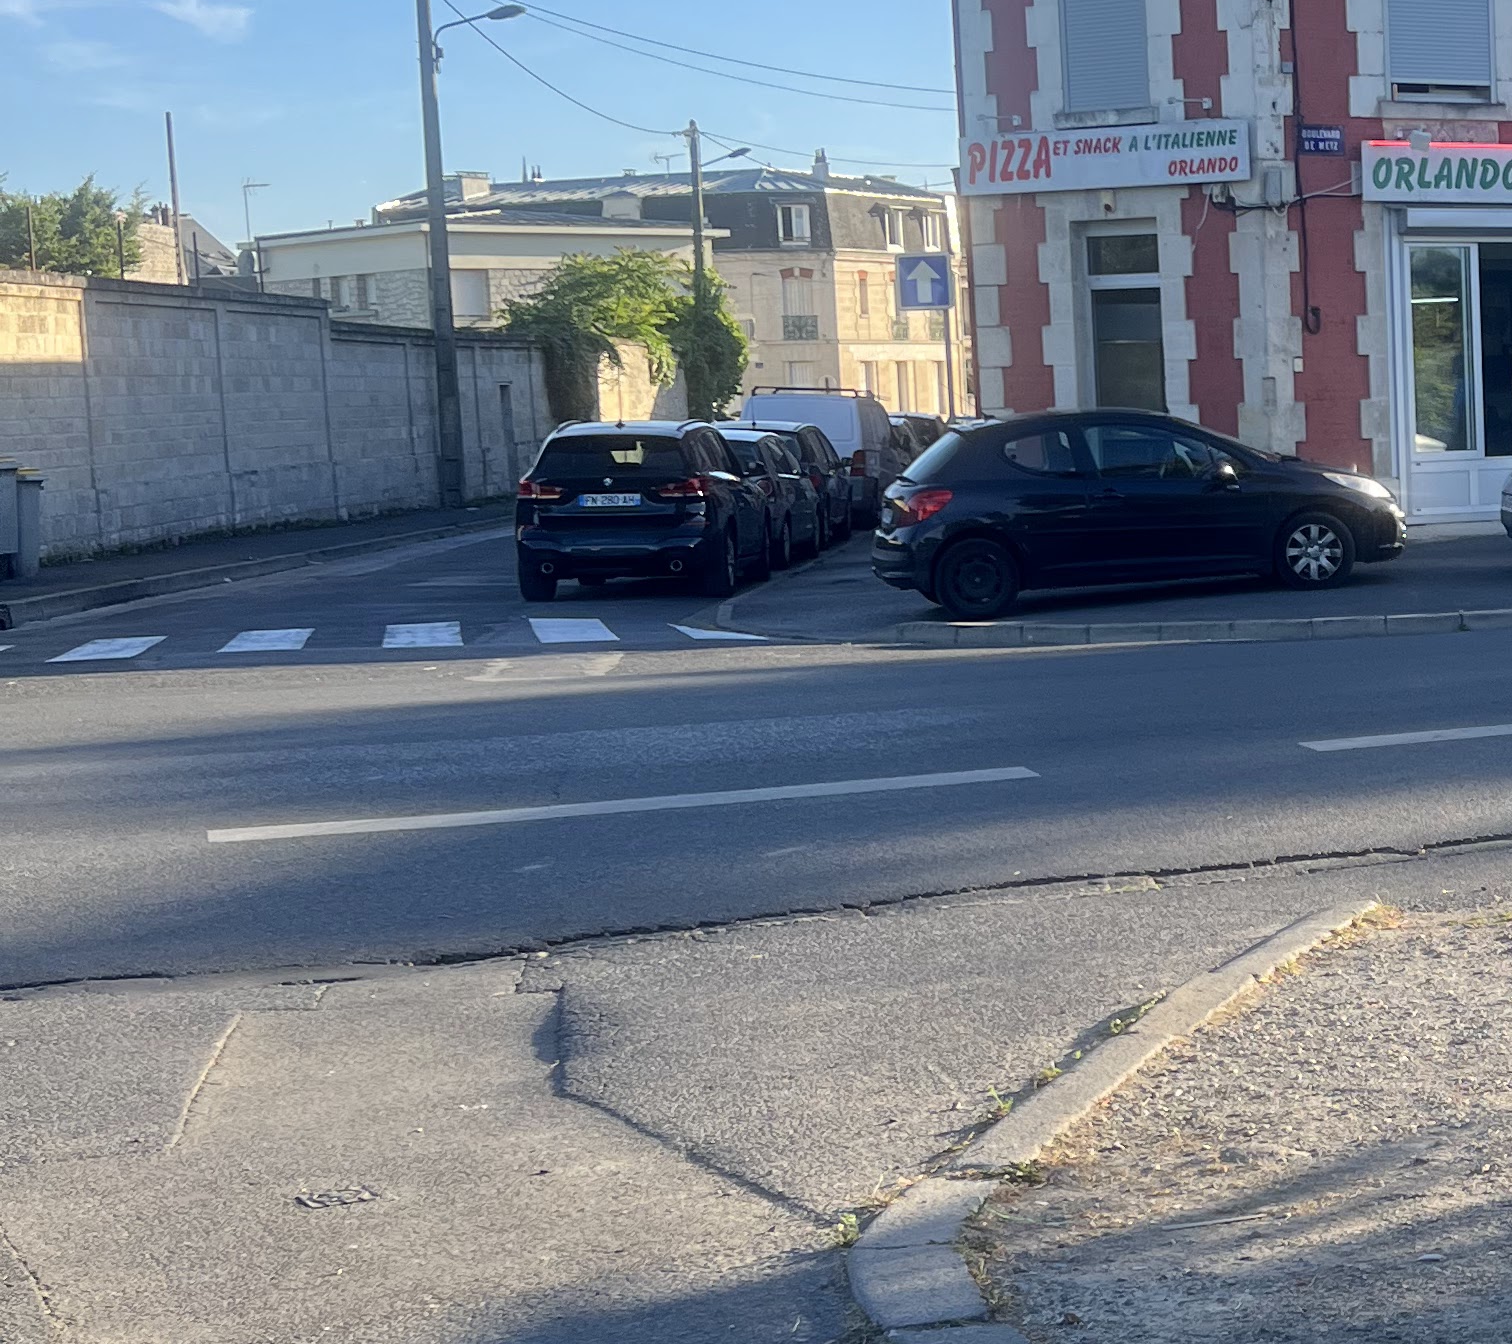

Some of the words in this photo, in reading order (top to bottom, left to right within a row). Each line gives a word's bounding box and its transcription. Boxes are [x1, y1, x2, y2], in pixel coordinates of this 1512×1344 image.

[967, 135, 1052, 185] PIZZA
[1053, 140, 1070, 156] ET
[1074, 137, 1122, 155] SNACK
[1128, 136, 1139, 152] A
[1144, 129, 1238, 151] L'ITALIENNE
[1168, 156, 1239, 176] ORLANDO
